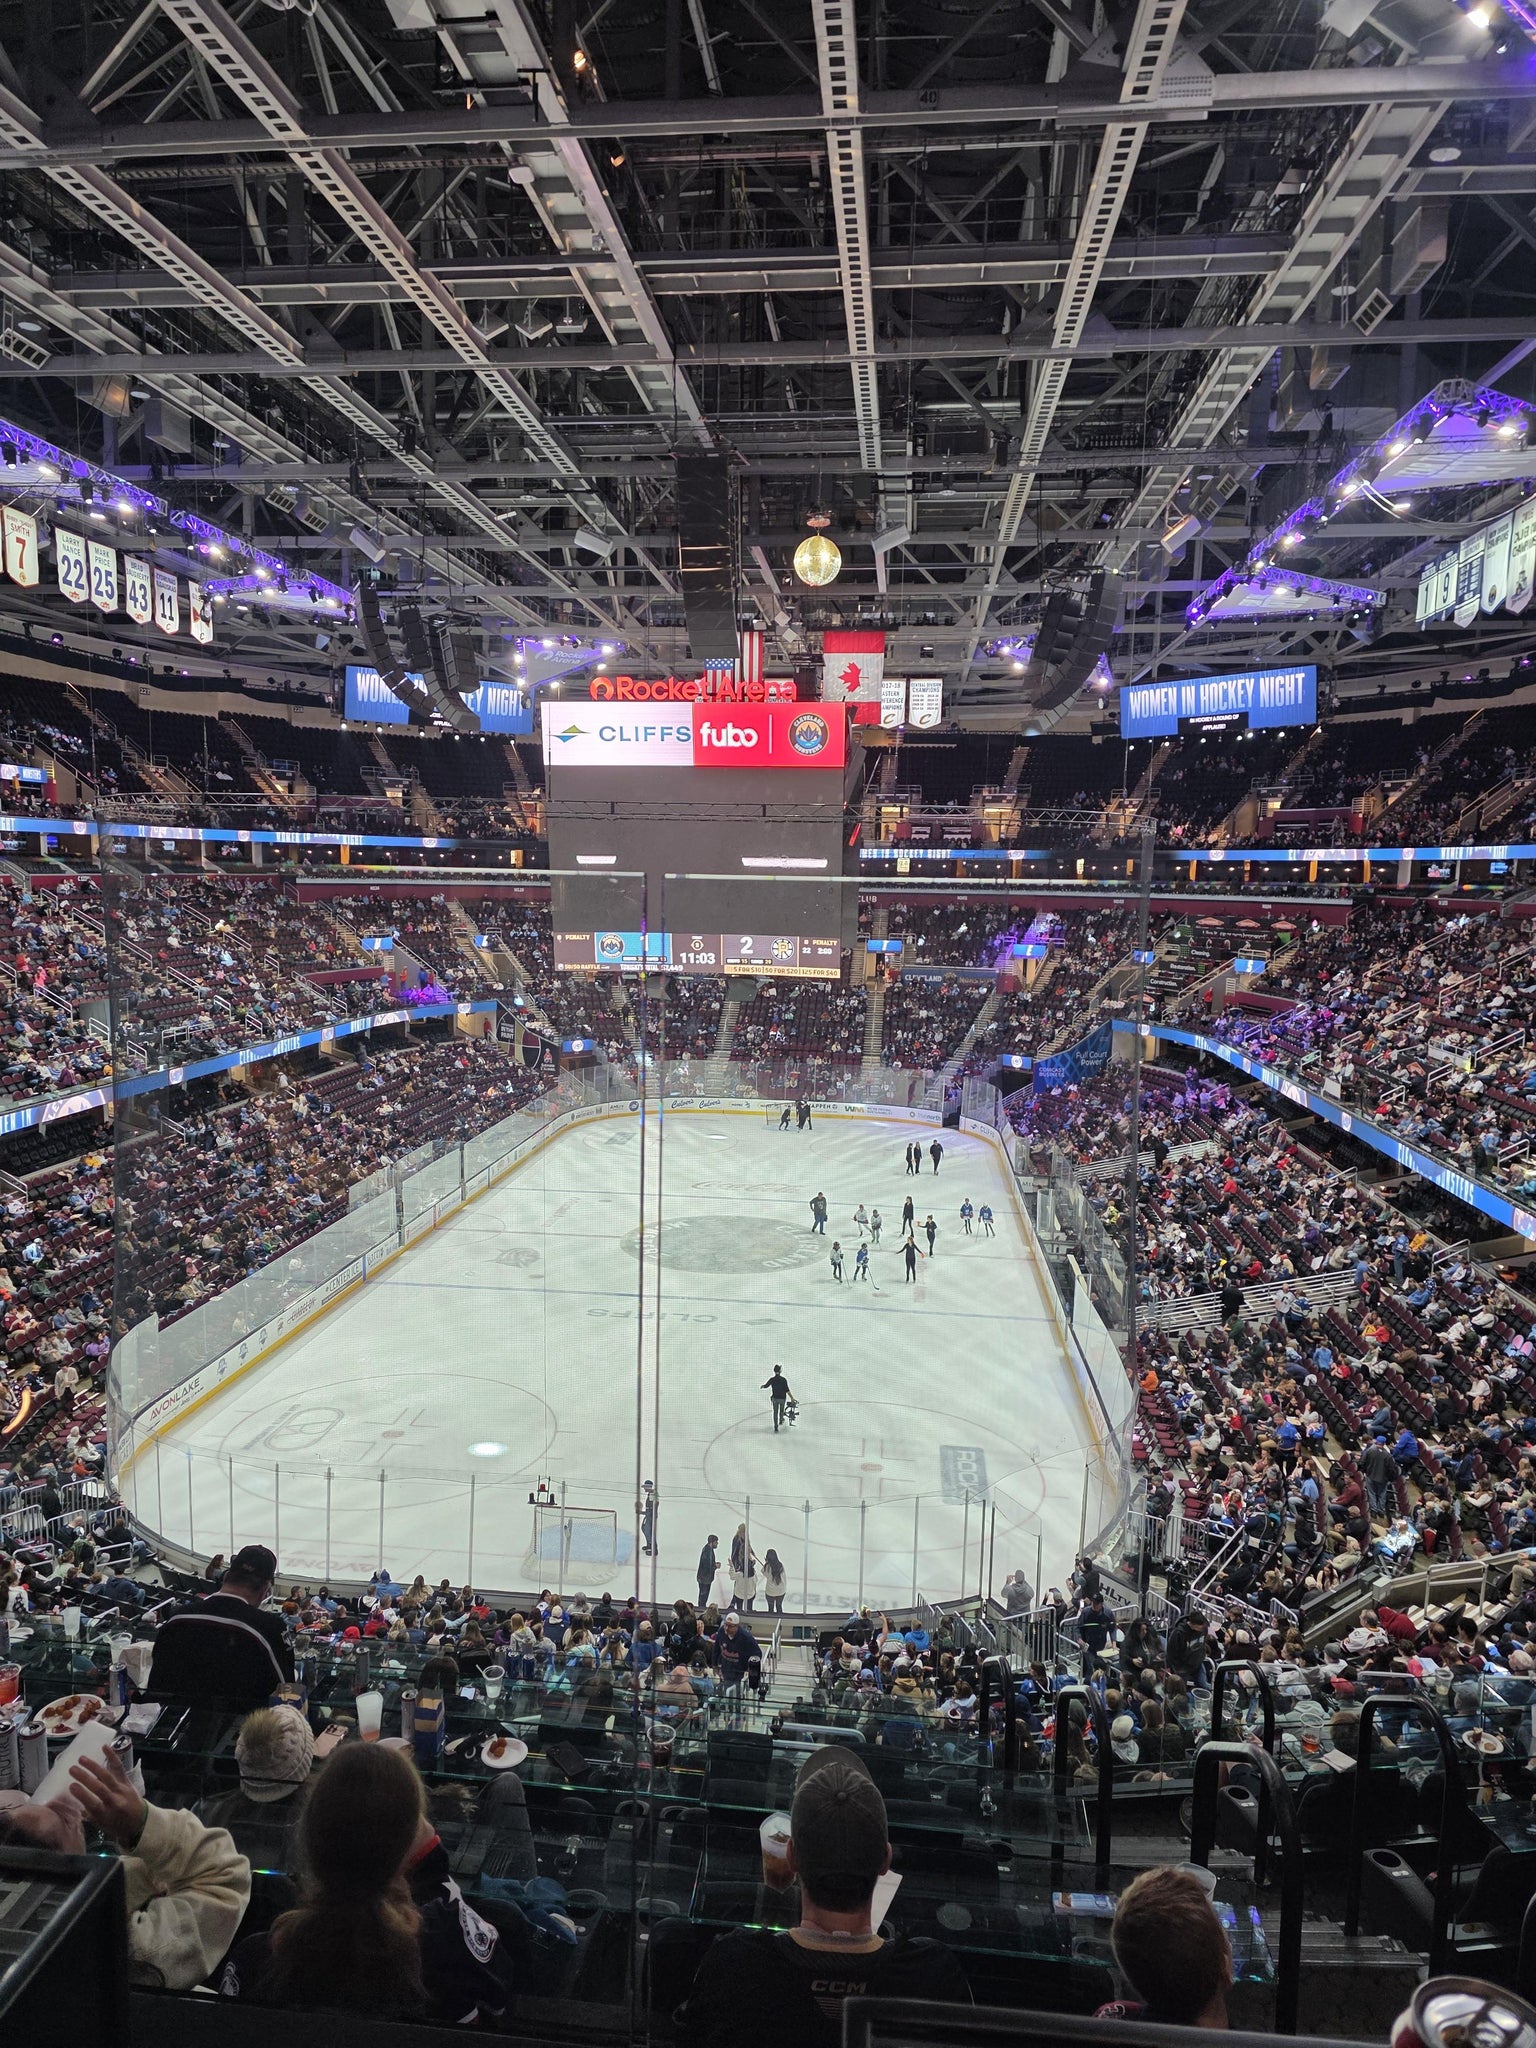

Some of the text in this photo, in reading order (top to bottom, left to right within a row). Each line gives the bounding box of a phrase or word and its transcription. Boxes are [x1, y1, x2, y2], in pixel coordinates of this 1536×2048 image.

[919, 90, 937, 104] 40
[10, 522, 30, 537] SMITH
[62, 534, 80, 547] LARRY
[15, 536, 26, 569] 7
[62, 543, 81, 556] NANCE
[94, 546, 110, 558] MARK
[94, 556, 110, 567] PRICE
[61, 554, 85, 590] 22
[93, 566, 115, 600] 25
[1442, 572, 1450, 604] 9
[129, 580, 148, 612] 43
[1422, 583, 1430, 614] 1
[159, 592, 175, 622] 11
[616, 676, 798, 701] Rocket Arena
[1129, 672, 1306, 719] WOMEN IN HOCKEY NIGHT
[792, 714, 826, 728] CLEVELAND
[598, 725, 692, 743] CLIFFS
[699, 721, 759, 748] fubo
[739, 936, 754, 955] 2
[679, 951, 716, 965] 11:03
[904, 974, 943, 982] CLEVELAND
[1075, 1050, 1108, 1059] Full Court
[1080, 1059, 1103, 1067] Power
[671, 1098, 695, 1109] Culver's
[698, 1098, 721, 1109] Culver's
[844, 1105, 865, 1113] WM
[329, 1260, 360, 1293] CENTER ICE
[1099, 1582, 1132, 1606] HLTV
[810, 1979, 868, 1994] CCM
